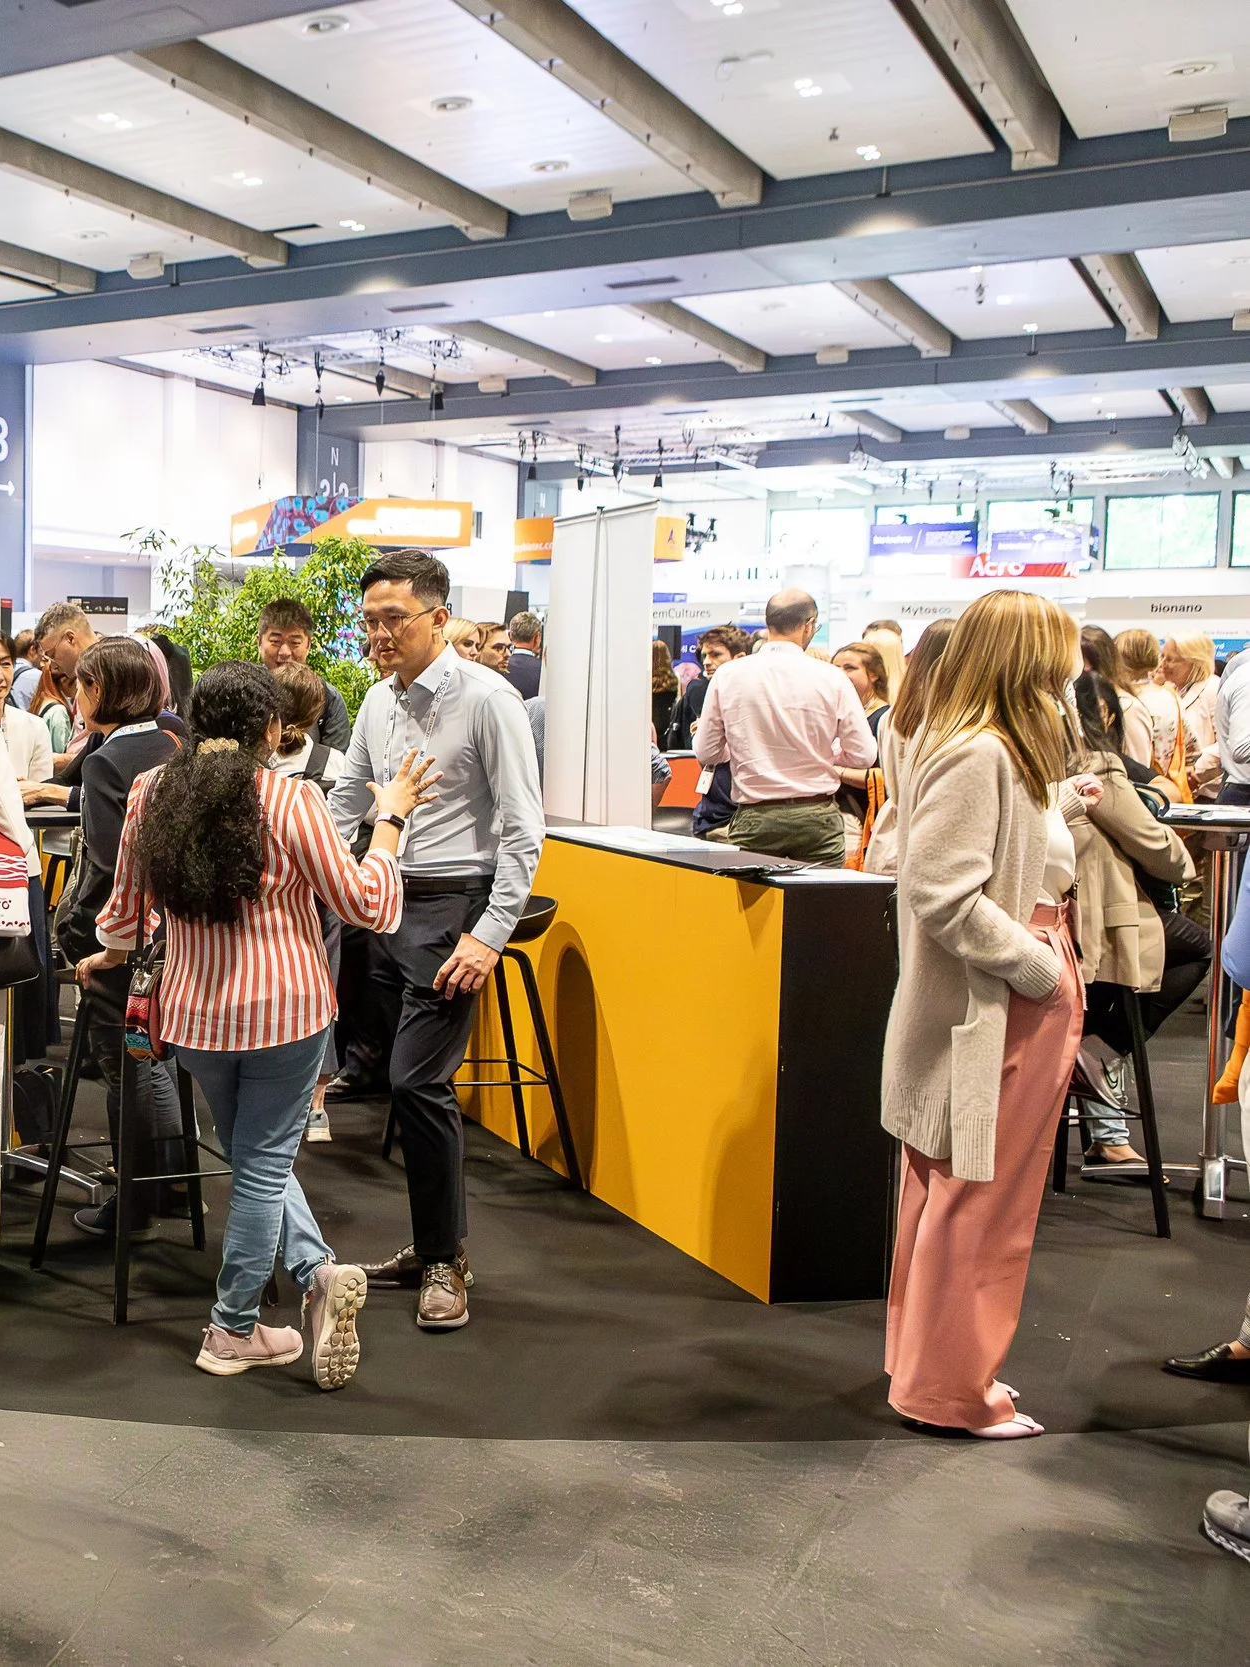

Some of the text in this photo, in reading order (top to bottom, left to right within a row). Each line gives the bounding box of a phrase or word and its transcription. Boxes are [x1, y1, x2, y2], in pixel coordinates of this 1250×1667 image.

[331, 446, 339, 466] N
[652, 607, 711, 619] emCultures
[1150, 603, 1202, 613] bionano
[435, 677, 449, 702] ISSCR
